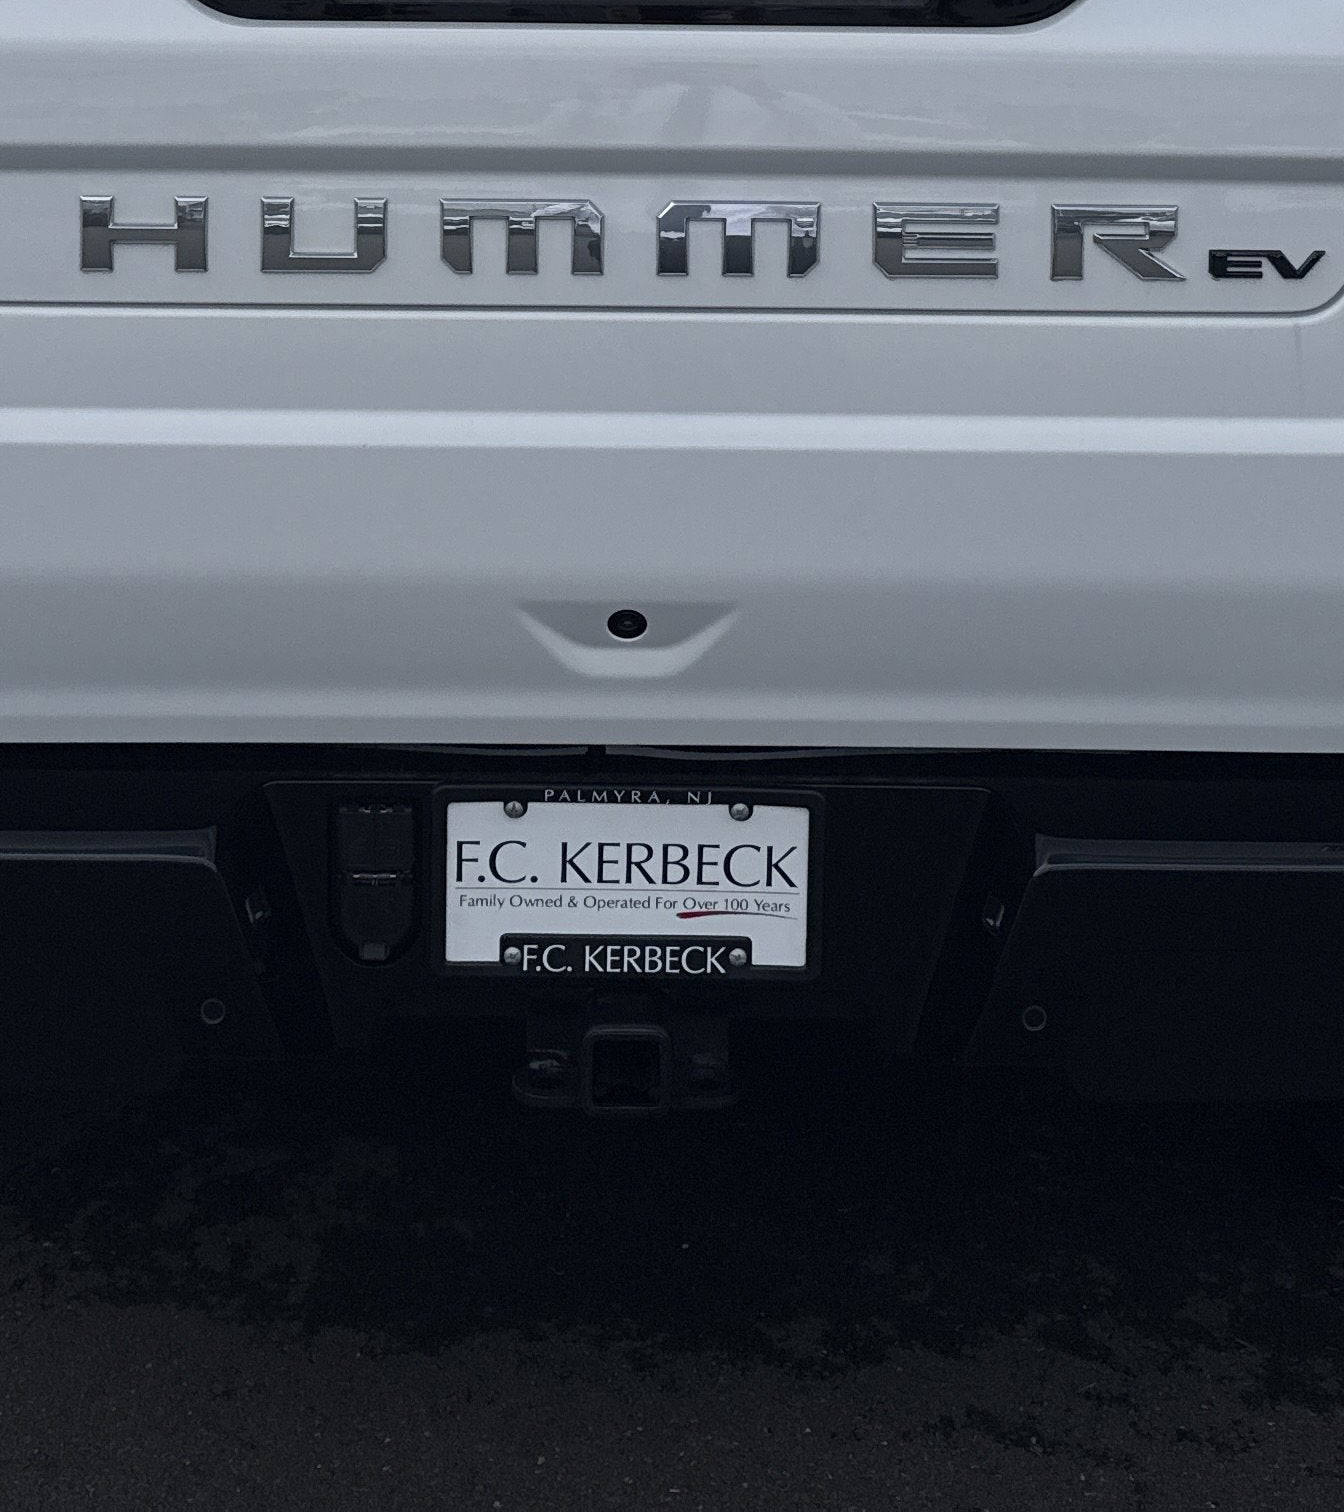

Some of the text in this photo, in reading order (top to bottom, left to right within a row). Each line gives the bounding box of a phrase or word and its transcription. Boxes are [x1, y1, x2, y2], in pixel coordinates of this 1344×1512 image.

[79, 194, 1326, 281] HUMMER EV
[545, 789, 714, 805] PALMYRA, NJ
[456, 840, 798, 888] F.C. KERBECK
[459, 894, 791, 913] Family Owned & Operated For Over 100 Years
[521, 943, 726, 974] F.C. KERBECK
